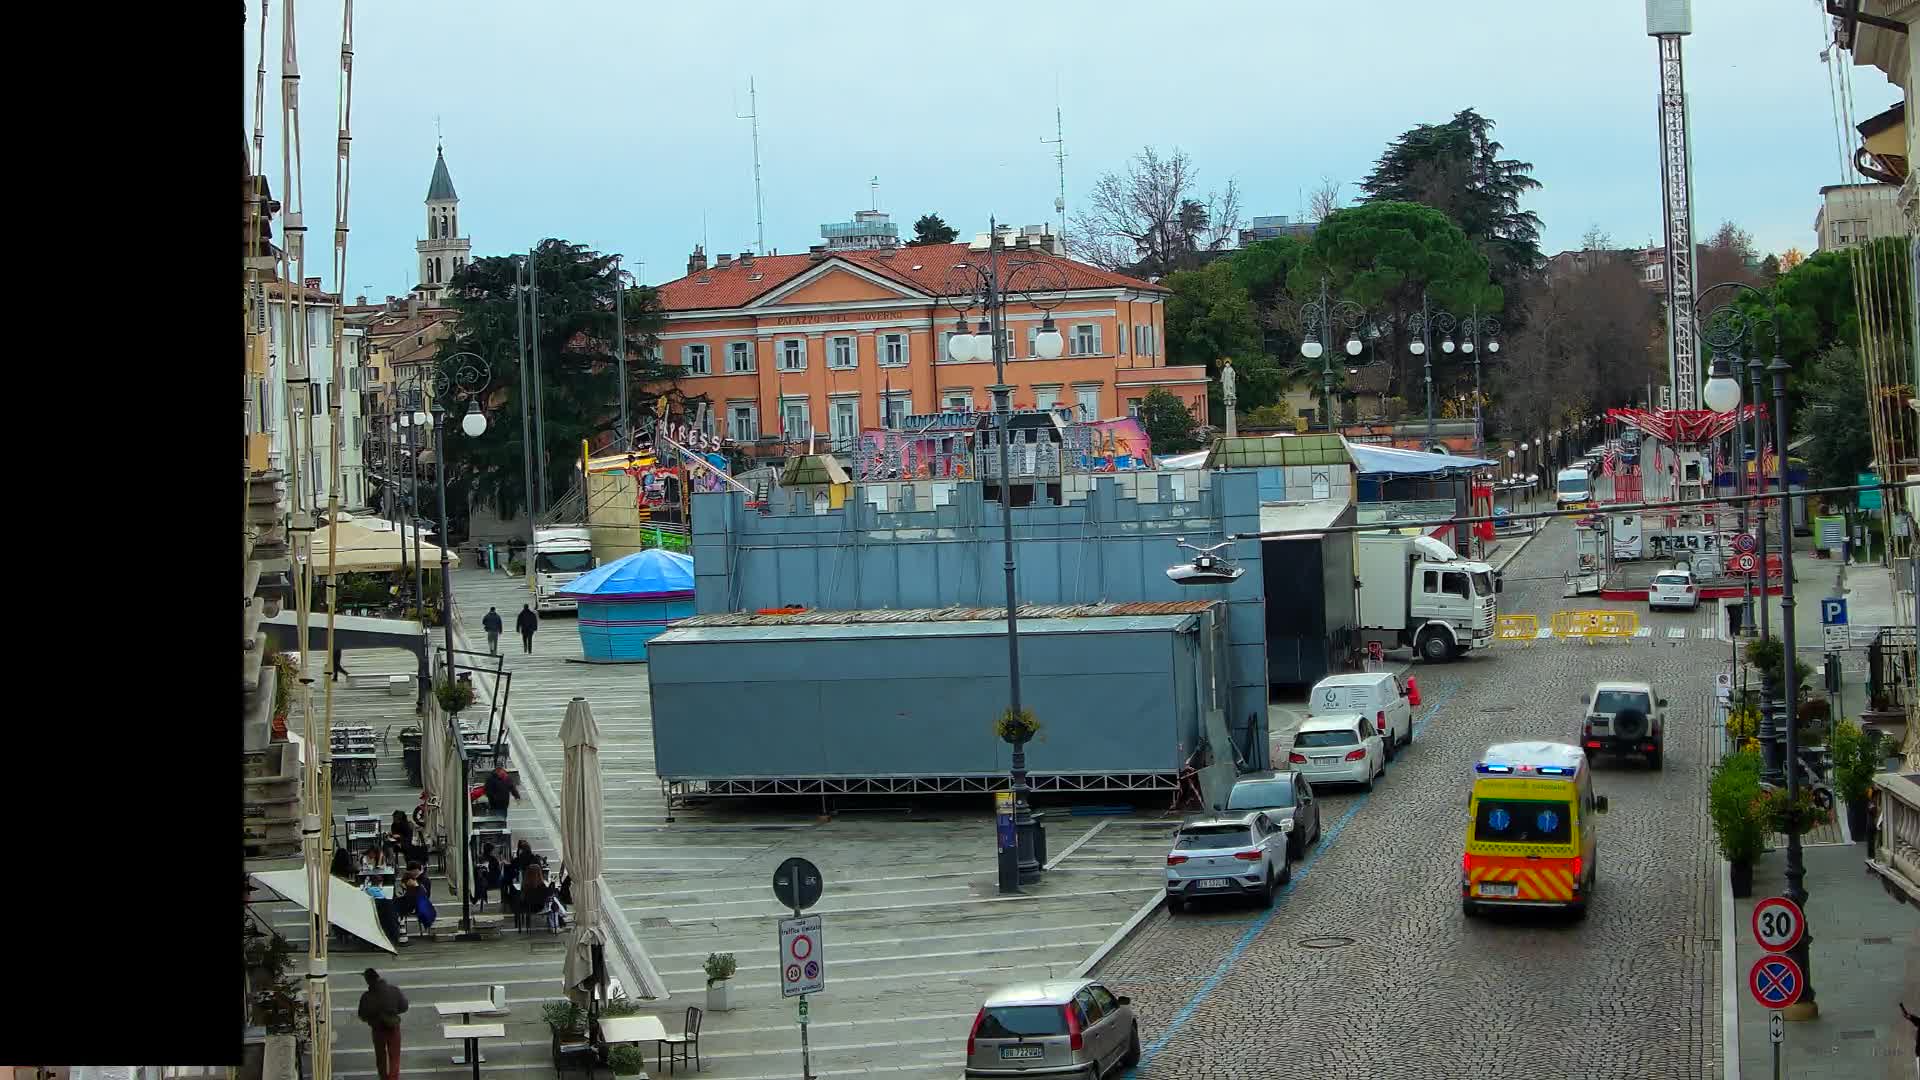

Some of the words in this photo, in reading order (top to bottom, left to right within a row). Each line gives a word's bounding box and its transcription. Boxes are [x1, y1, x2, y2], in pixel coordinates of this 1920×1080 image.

[777, 315, 821, 326] PALAZZO
[1742, 558, 1752, 567] 20
[1827, 602, 1842, 622] P
[1762, 911, 1791, 938] 30
[790, 968, 798, 979] 20
